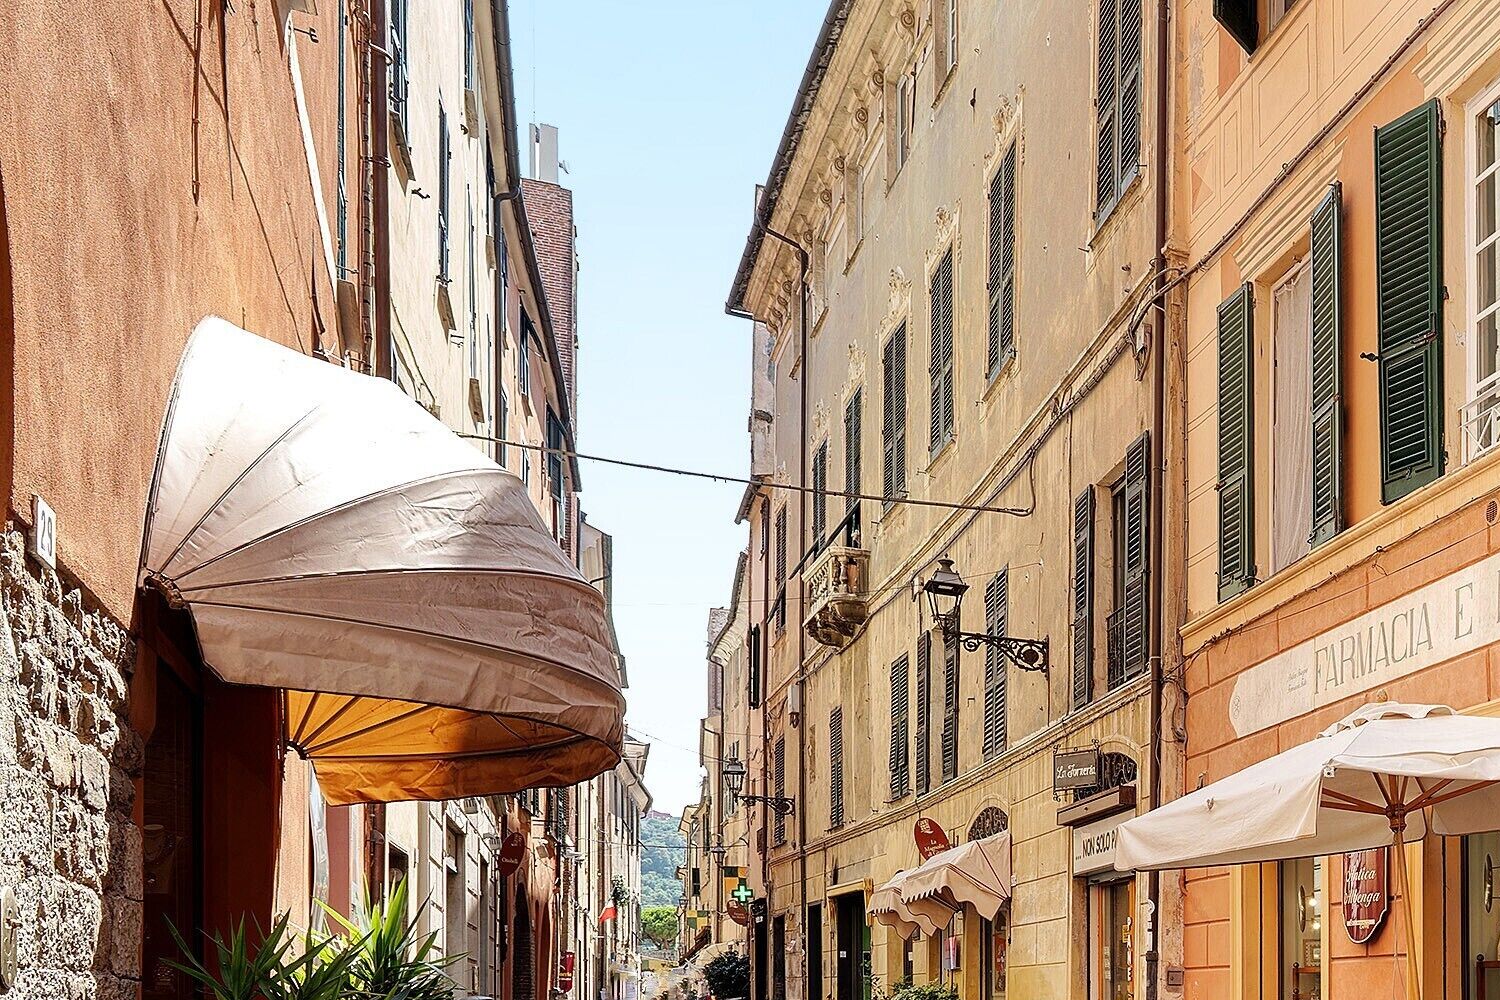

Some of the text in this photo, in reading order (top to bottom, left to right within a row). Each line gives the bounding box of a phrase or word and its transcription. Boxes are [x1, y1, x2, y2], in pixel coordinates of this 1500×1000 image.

[39, 509, 53, 558] 29
[1314, 601, 1433, 696] FARMACIA
[1453, 582, 1476, 642] E
[1056, 765, 1067, 779] La
[1082, 836, 1095, 857] NON
[1095, 832, 1110, 854] SOLO
